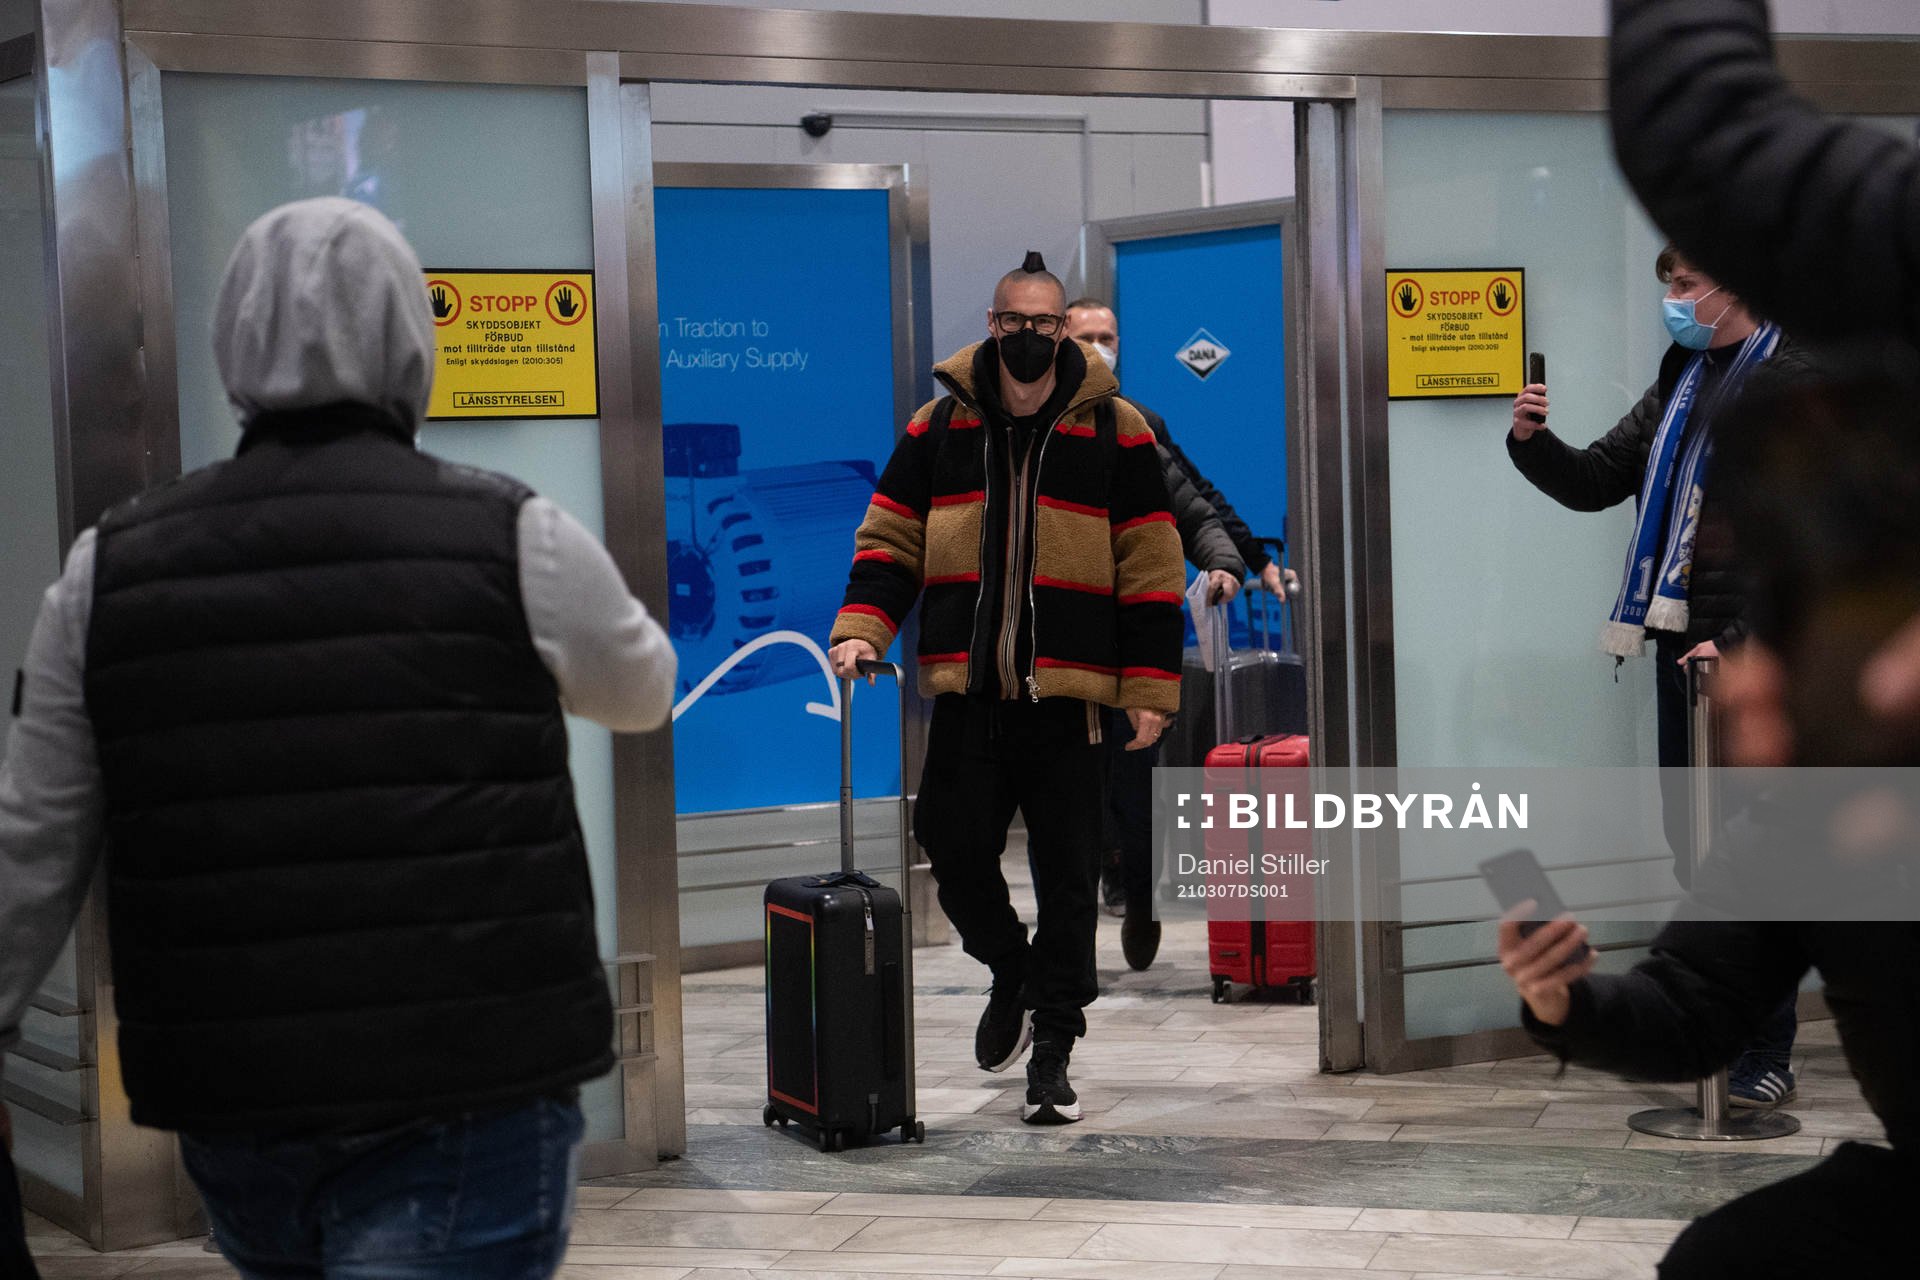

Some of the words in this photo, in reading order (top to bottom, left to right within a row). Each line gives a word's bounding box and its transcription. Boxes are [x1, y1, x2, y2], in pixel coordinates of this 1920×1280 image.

[1430, 291, 1481, 306] STOPP
[470, 295, 538, 313] STOPP
[1426, 312, 1483, 321] SKYDDSOBJEKT
[466, 320, 541, 330] SKYDDSOBJEKT
[674, 317, 745, 338] Traction
[752, 319, 769, 337] to
[1440, 322, 1470, 332] FÖRBUD
[485, 332, 524, 343] FÖRBUD
[1427, 333, 1457, 341] tillträde
[1460, 333, 1476, 341] utan
[1479, 332, 1508, 340] tillstånd
[443, 345, 462, 353] mot
[467, 344, 506, 353] tillträde
[511, 344, 532, 353] utan
[536, 343, 576, 353] tillstånd
[665, 348, 740, 373] Auxiliary
[745, 347, 808, 372] Supply
[1188, 349, 1217, 361] DANA
[446, 358, 467, 367] Enligt
[470, 358, 519, 366] skyddslagen
[522, 357, 563, 365] (2010:305)
[1421, 376, 1495, 386] LÄNSSTYRELSEN
[461, 393, 557, 406] LÄNSSTYRELSEN
